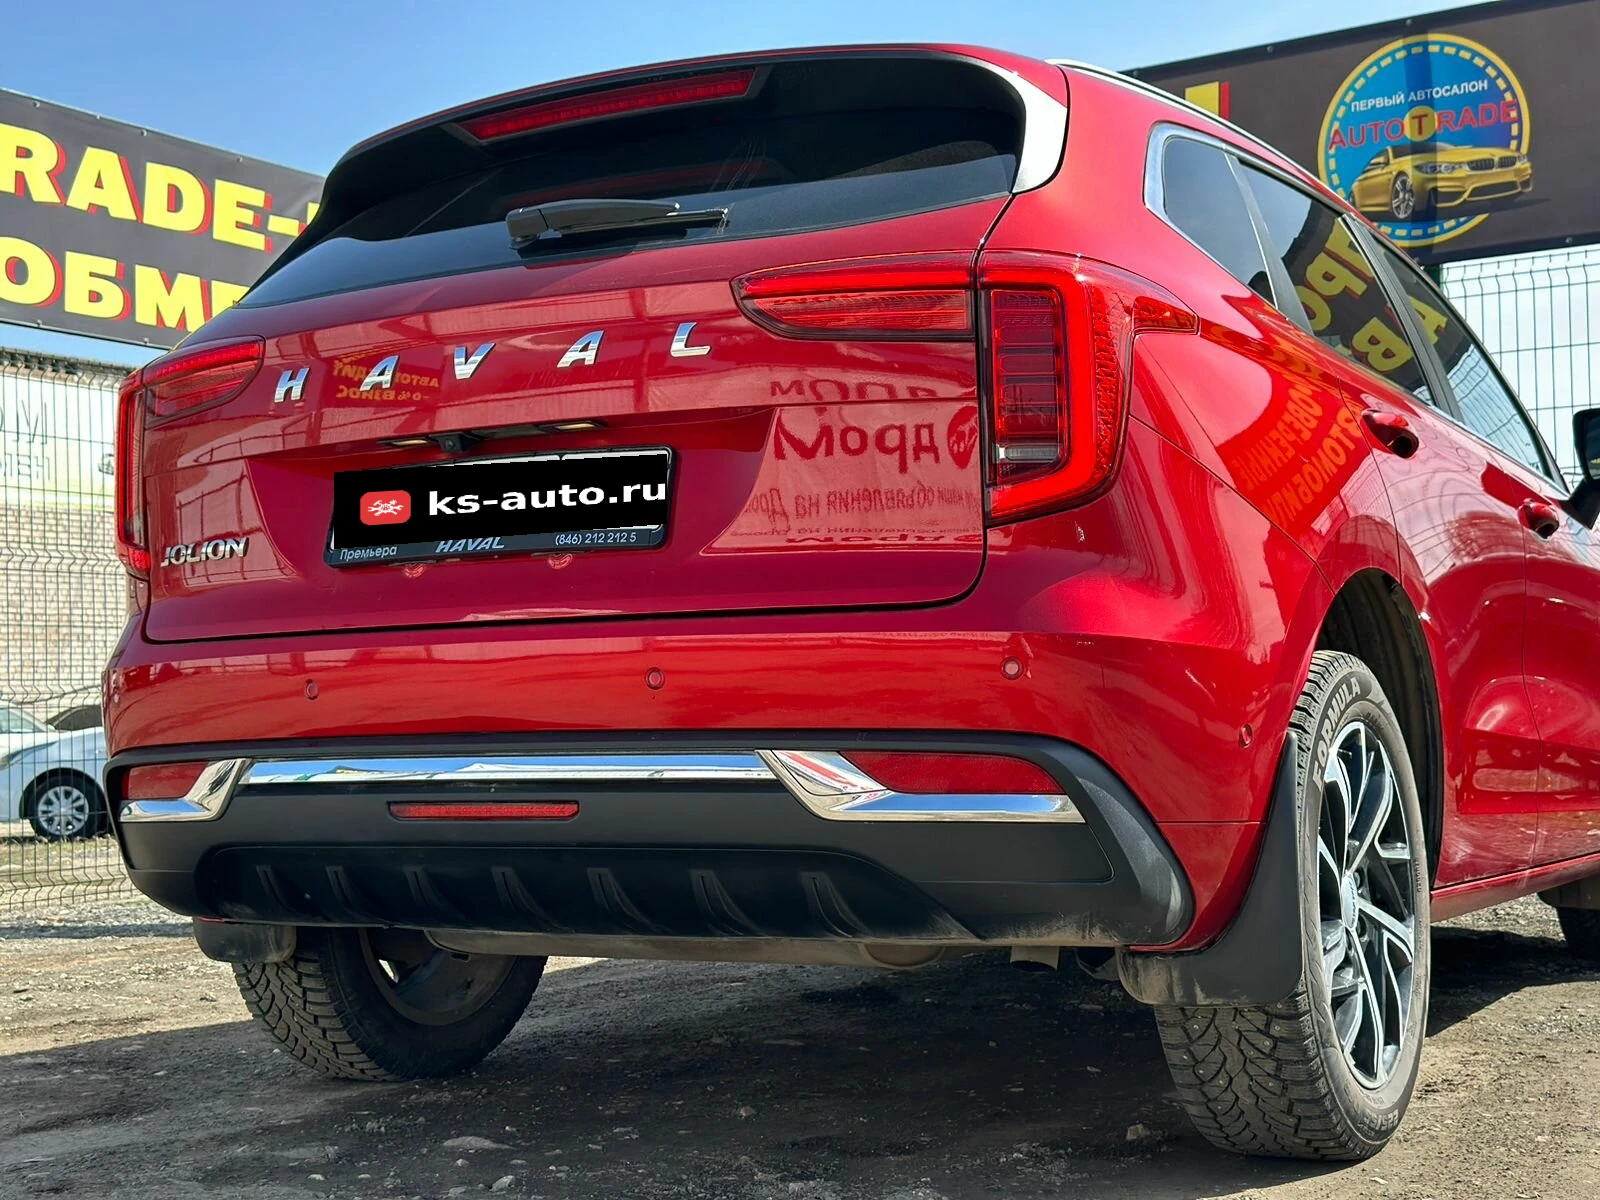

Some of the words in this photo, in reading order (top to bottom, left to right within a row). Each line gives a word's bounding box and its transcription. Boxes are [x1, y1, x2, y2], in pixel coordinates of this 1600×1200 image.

[1351, 92, 1405, 112] ПЕРВЫЙ
[1408, 79, 1488, 102] АВТОСАЛОН
[1328, 99, 1519, 151] AUTOTRADE
[274, 322, 711, 403] HAVAL
[160, 536, 248, 567] JOLION
[339, 545, 397, 562] Премьера
[435, 536, 505, 553] HAVAL
[554, 532, 582, 546] (846)
[585, 532, 605, 544] 212
[607, 532, 628, 544] 212
[629, 531, 637, 542] 5
[1312, 677, 1361, 792] FORMULA
